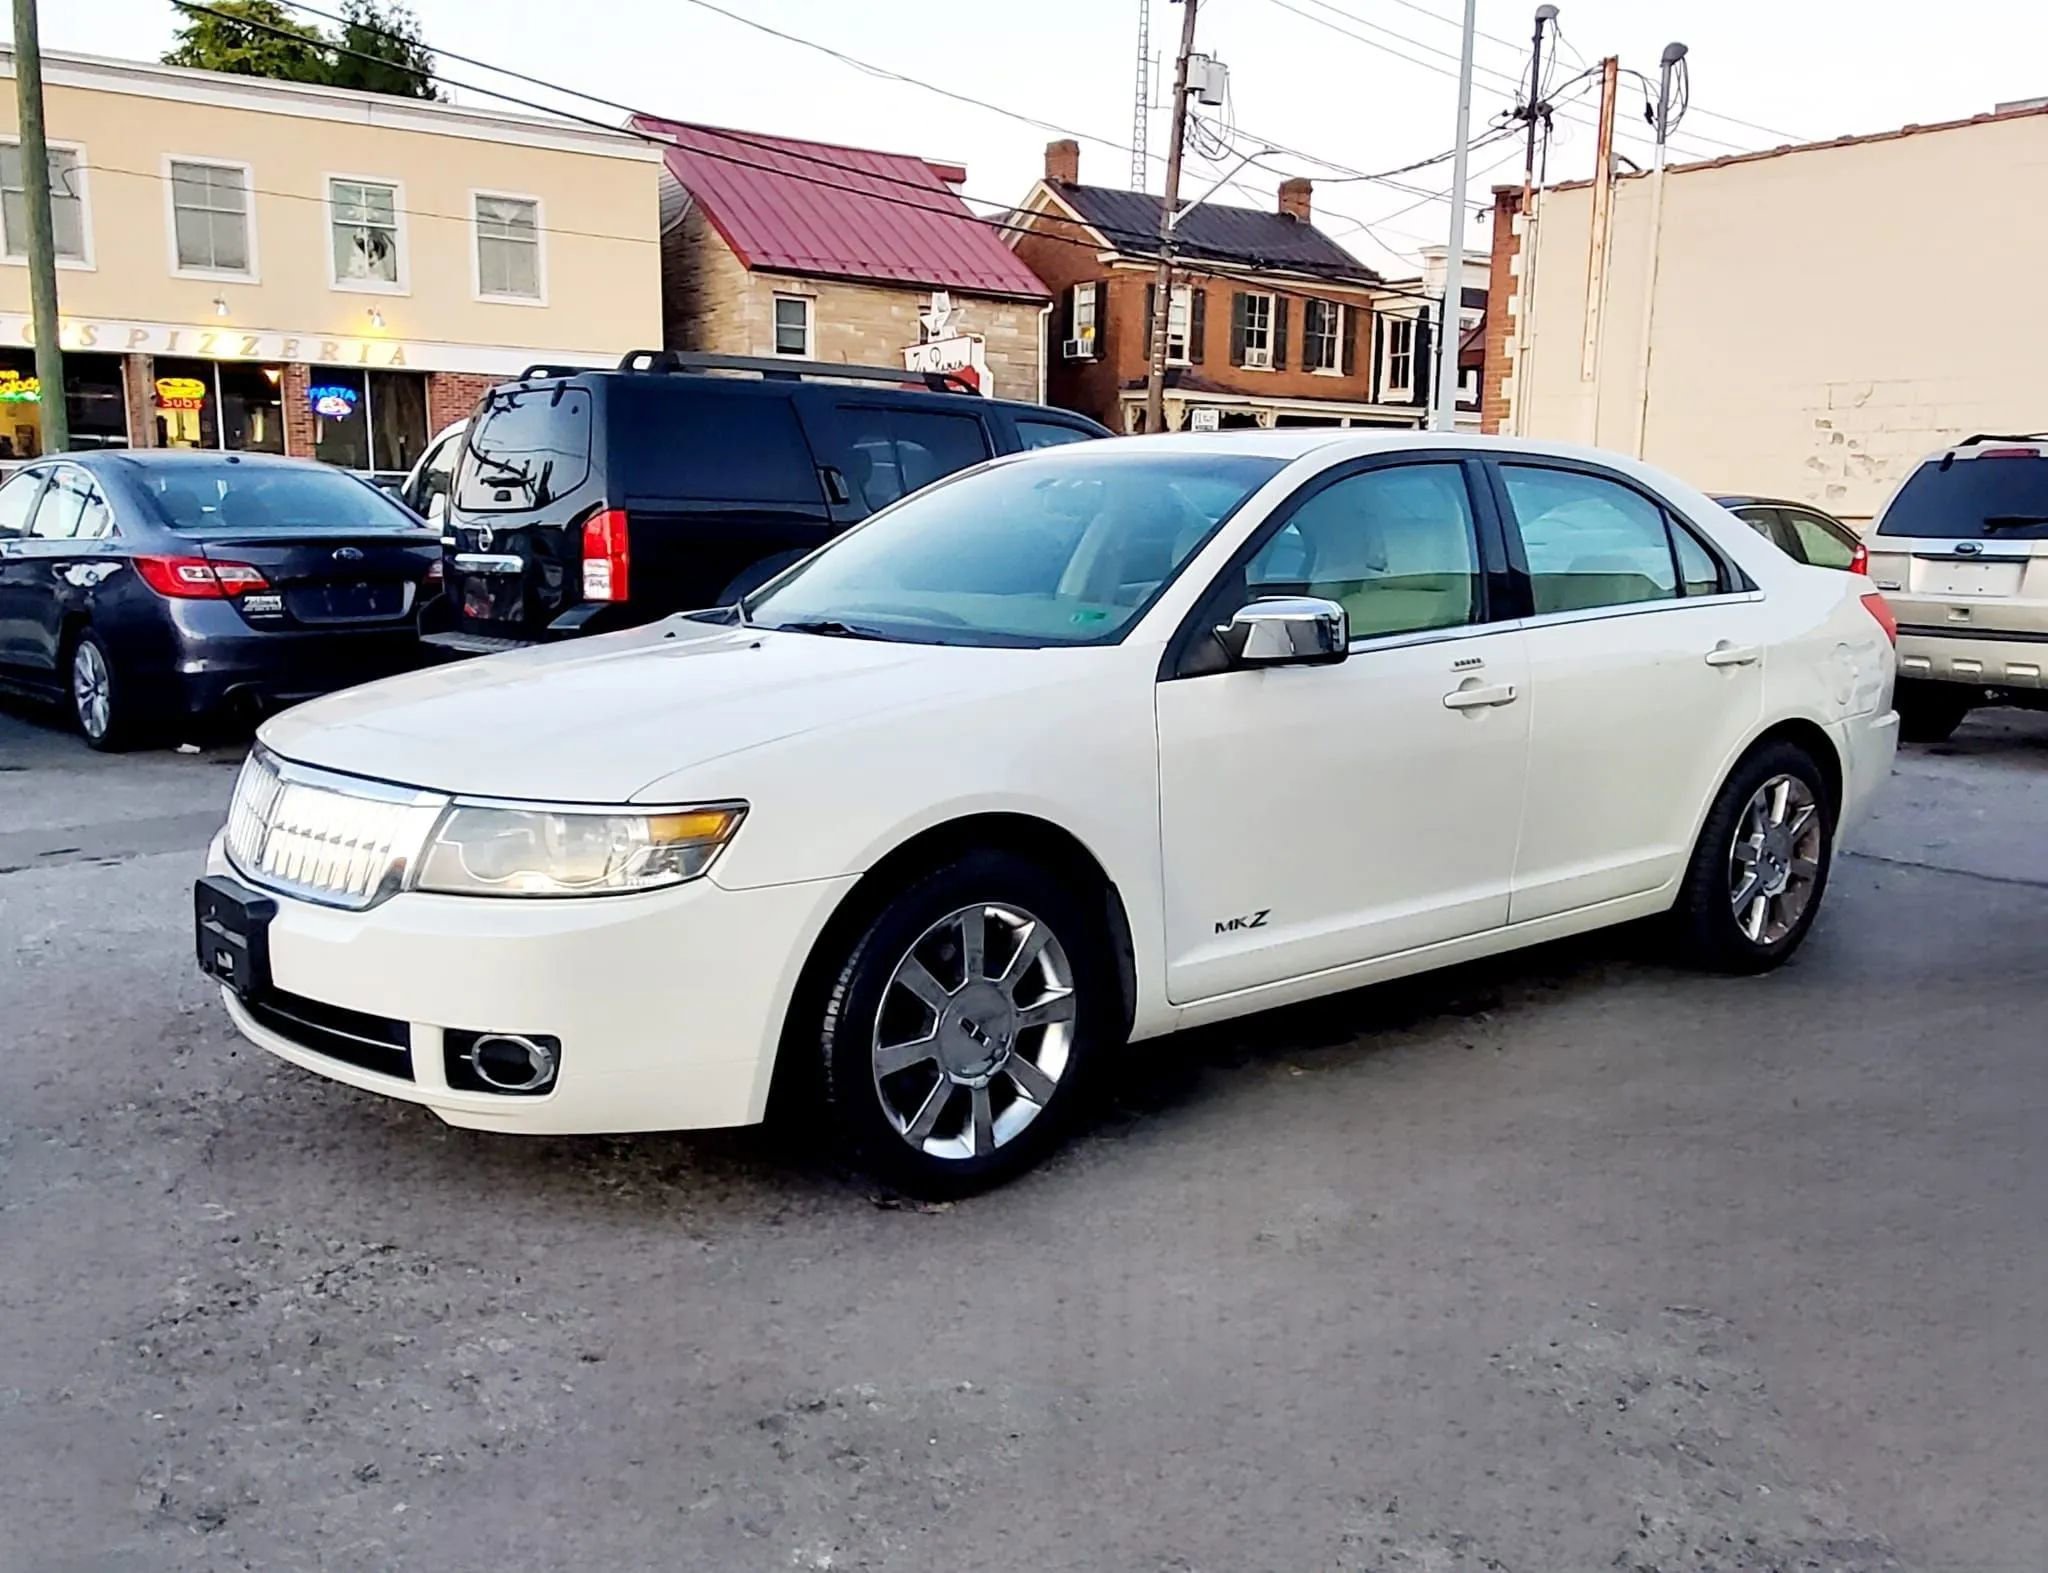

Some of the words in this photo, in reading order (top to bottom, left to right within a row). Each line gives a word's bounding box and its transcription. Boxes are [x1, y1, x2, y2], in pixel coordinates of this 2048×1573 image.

[125, 328, 407, 366] PIZZERIA
[310, 387, 357, 402] PASTA
[1214, 908, 1271, 934] MKZ
